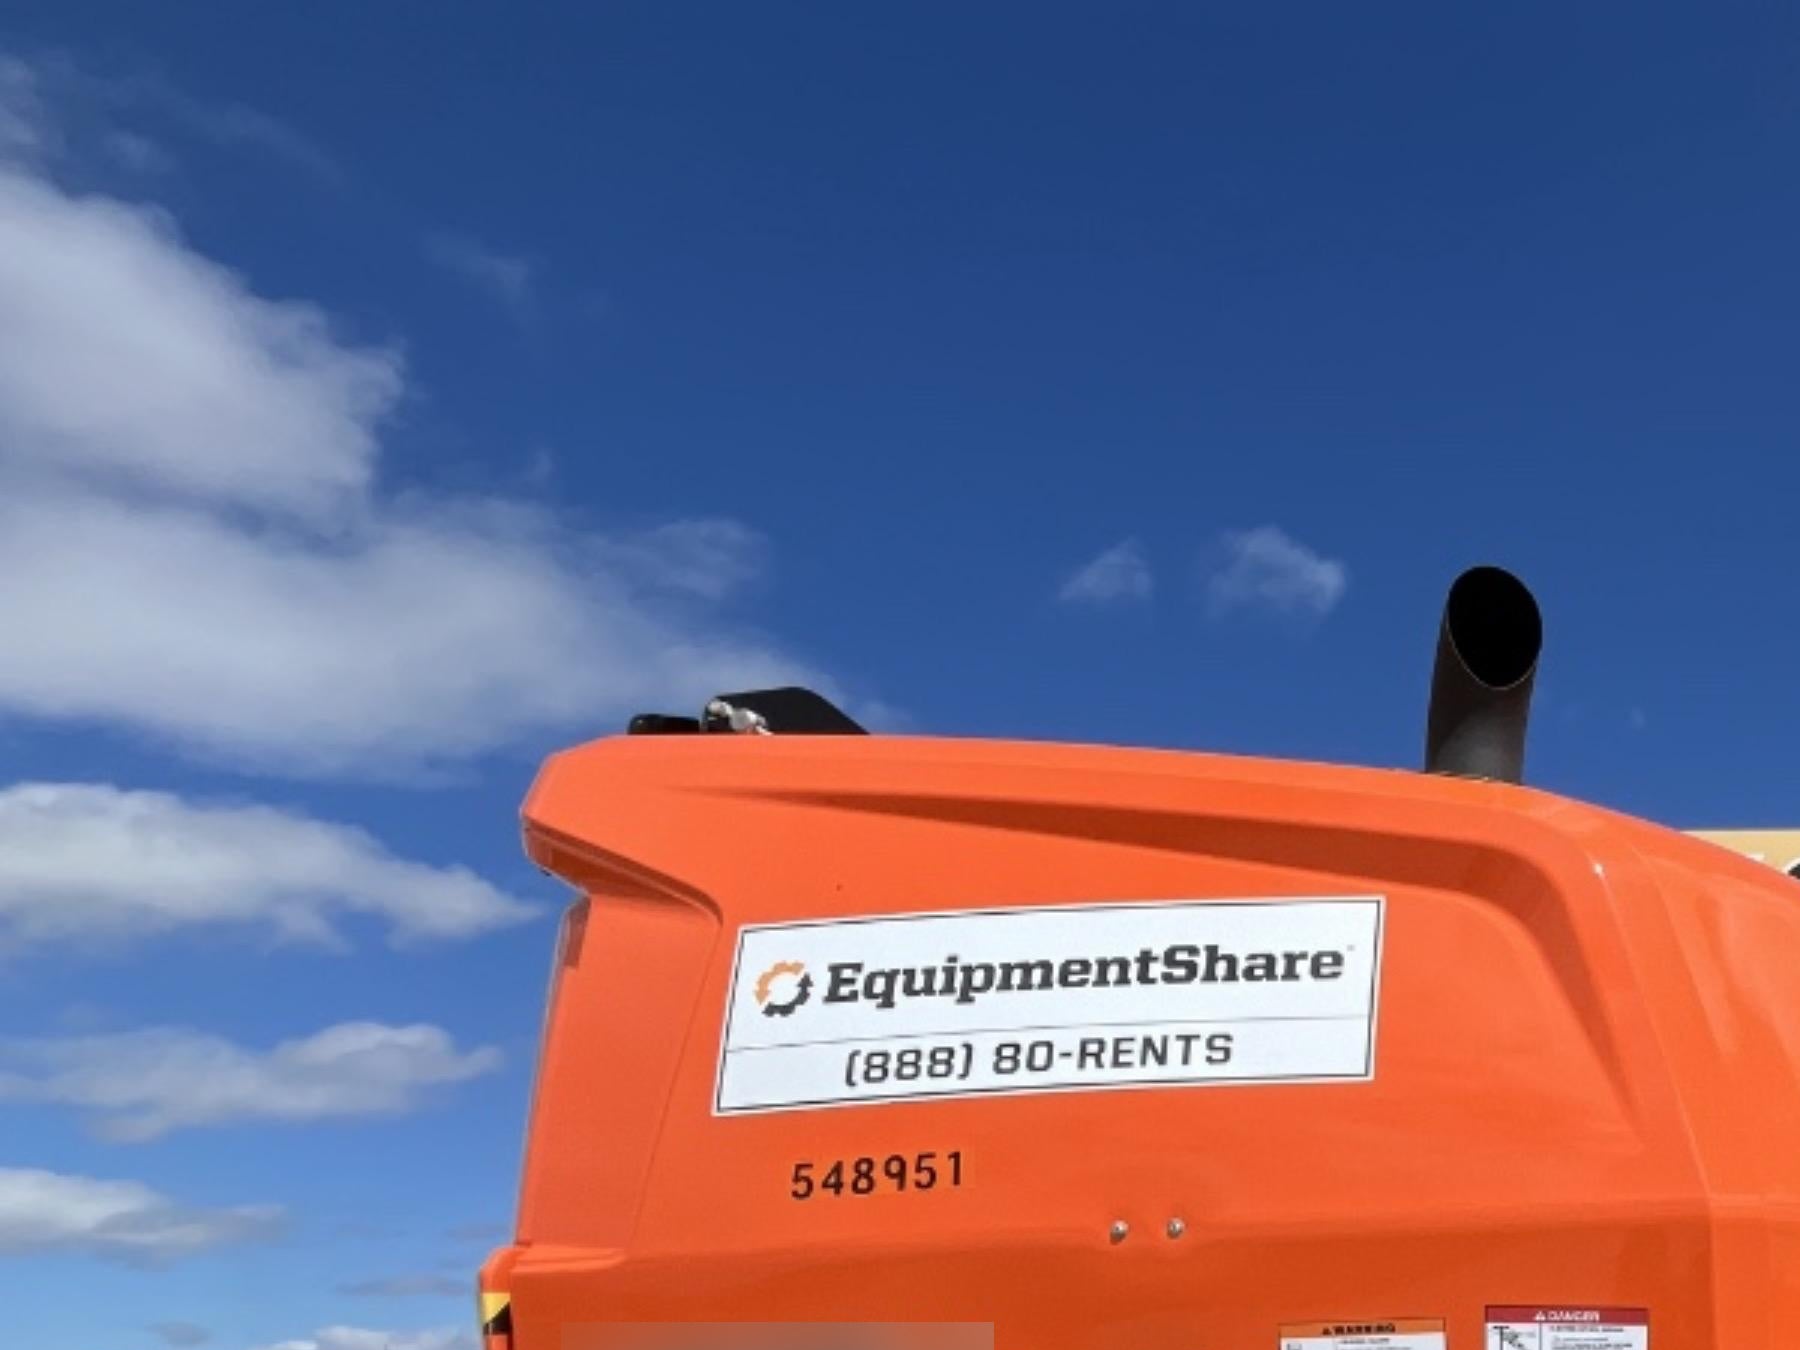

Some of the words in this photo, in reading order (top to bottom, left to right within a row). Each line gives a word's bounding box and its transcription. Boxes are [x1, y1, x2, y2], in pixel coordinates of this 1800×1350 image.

[823, 944, 1344, 1009] EquipmentShare
[845, 1042, 973, 1087] (888)
[992, 1033, 1234, 1076] 80-RENTS
[790, 1150, 963, 1201] 548951
